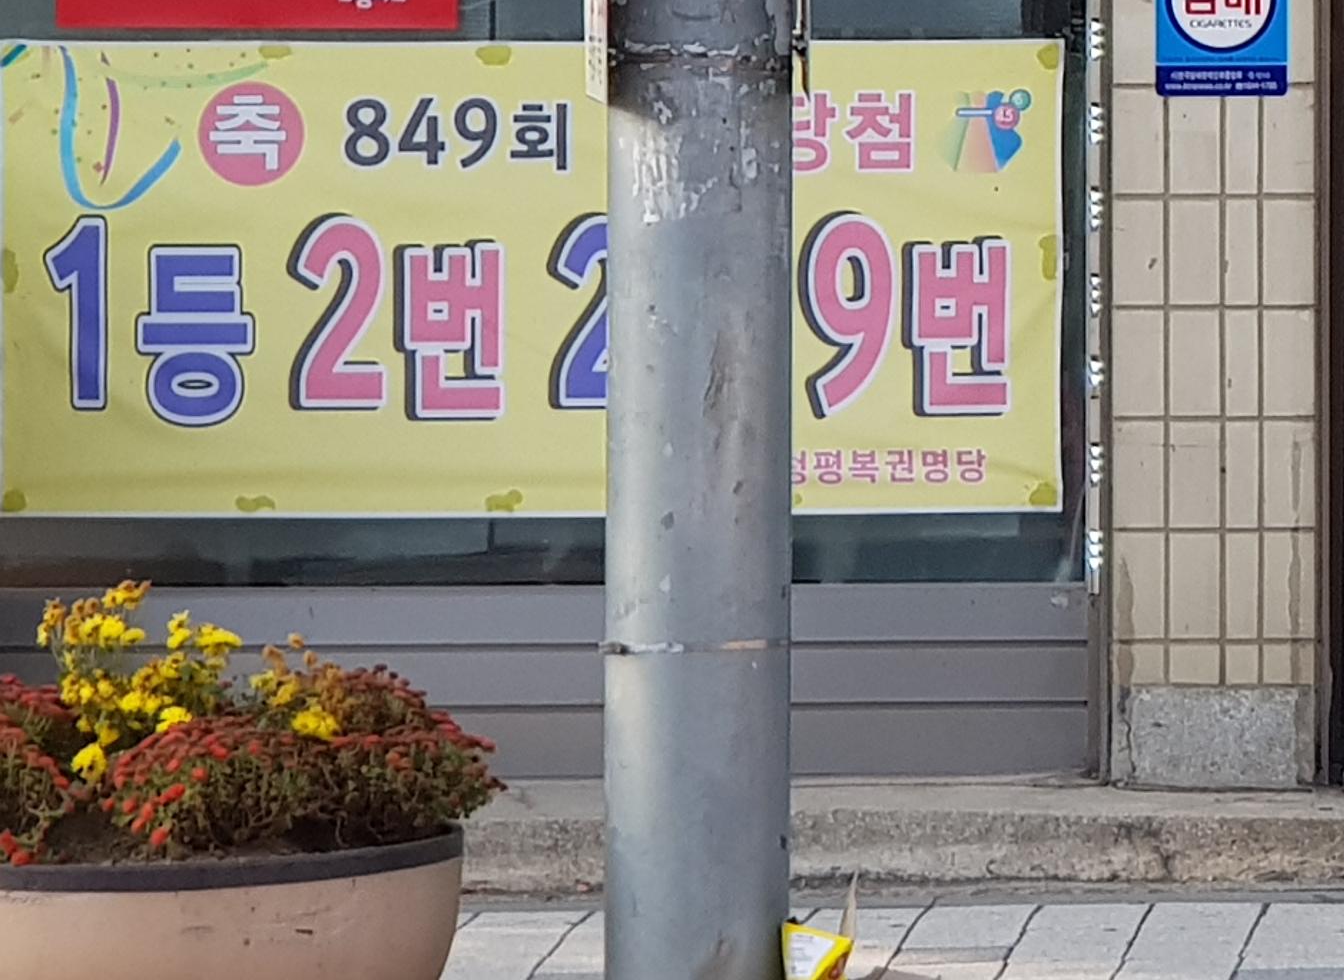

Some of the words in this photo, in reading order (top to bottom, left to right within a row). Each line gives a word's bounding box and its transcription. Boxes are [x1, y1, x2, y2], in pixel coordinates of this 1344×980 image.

[1190, 20, 1252, 28] CIGARETTES
[208, 91, 287, 170] 축
[341, 95, 571, 173] 849회
[793, 93, 913, 171] 당첨
[44, 214, 256, 427] 1등
[287, 211, 508, 421] 2번
[798, 210, 1010, 422] 9번
